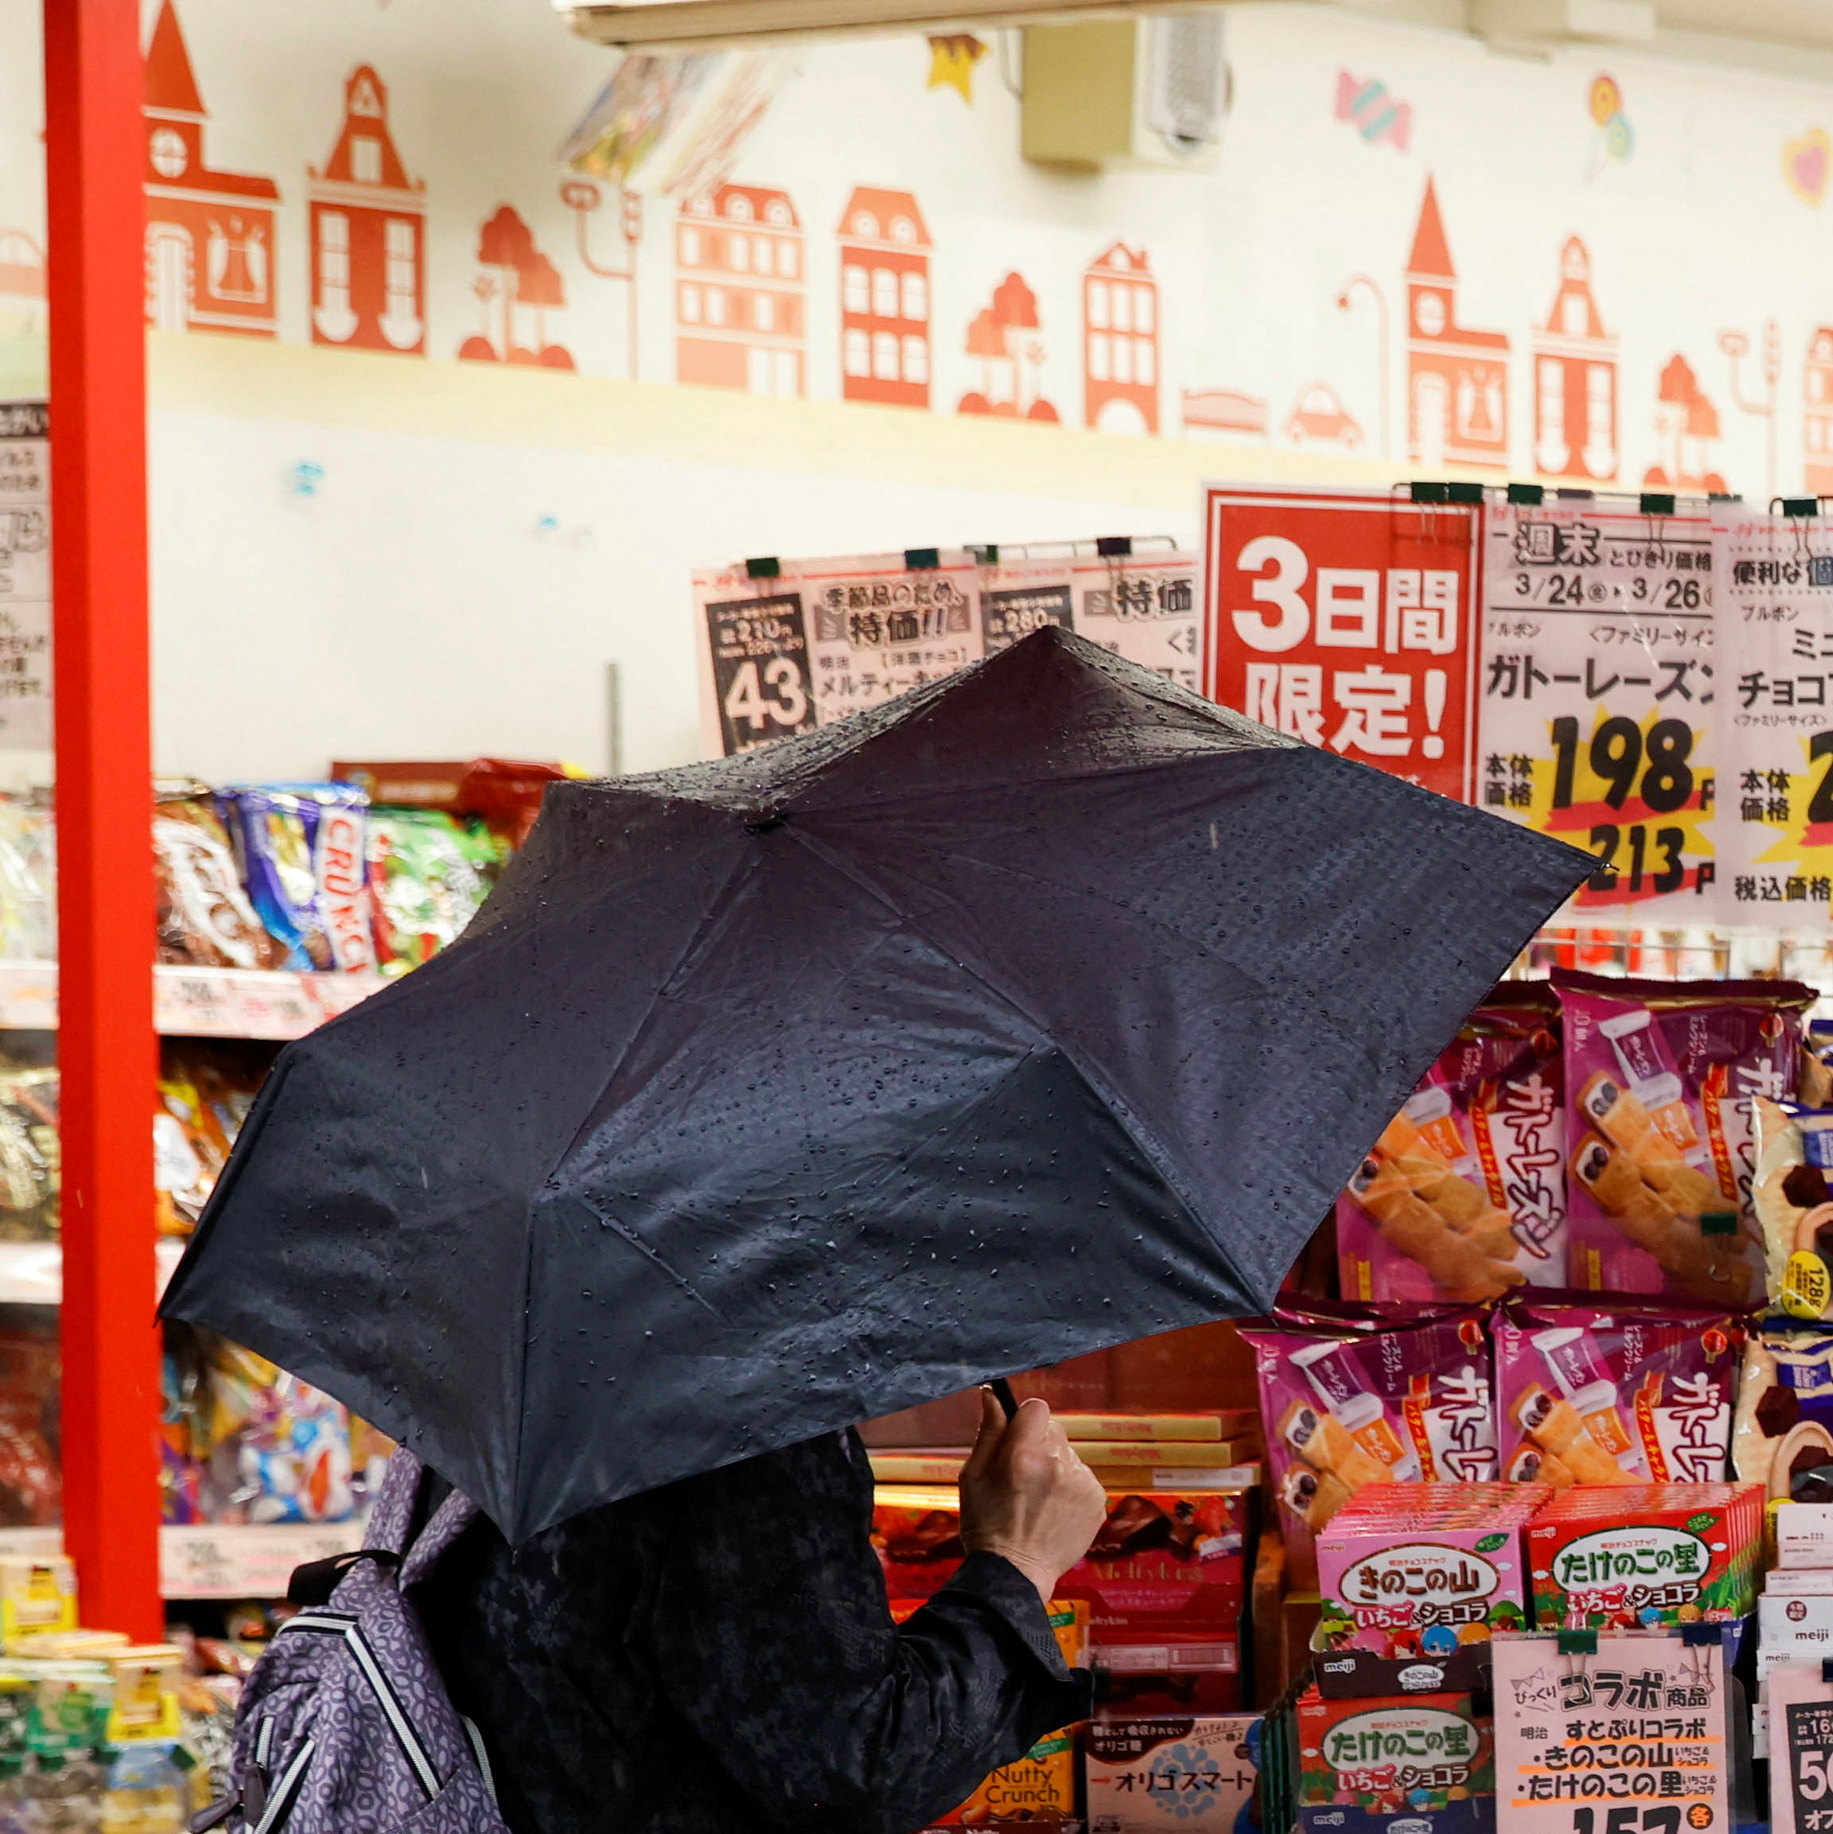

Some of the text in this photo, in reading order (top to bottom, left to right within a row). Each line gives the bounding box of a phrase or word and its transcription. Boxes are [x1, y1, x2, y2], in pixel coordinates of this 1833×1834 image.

[1514, 518, 1599, 566] 週末
[1233, 535, 1459, 653] 3日間
[1244, 661, 1445, 759] 限定!
[1358, 1560, 1480, 1595] きのこの山
[1561, 1541, 1700, 1582] たけのこの里
[1560, 1671, 1664, 1711] コラボ
[1331, 1726, 1471, 1763] たけのこの里
[1566, 1717, 1707, 1740] すとぷりコラボ
